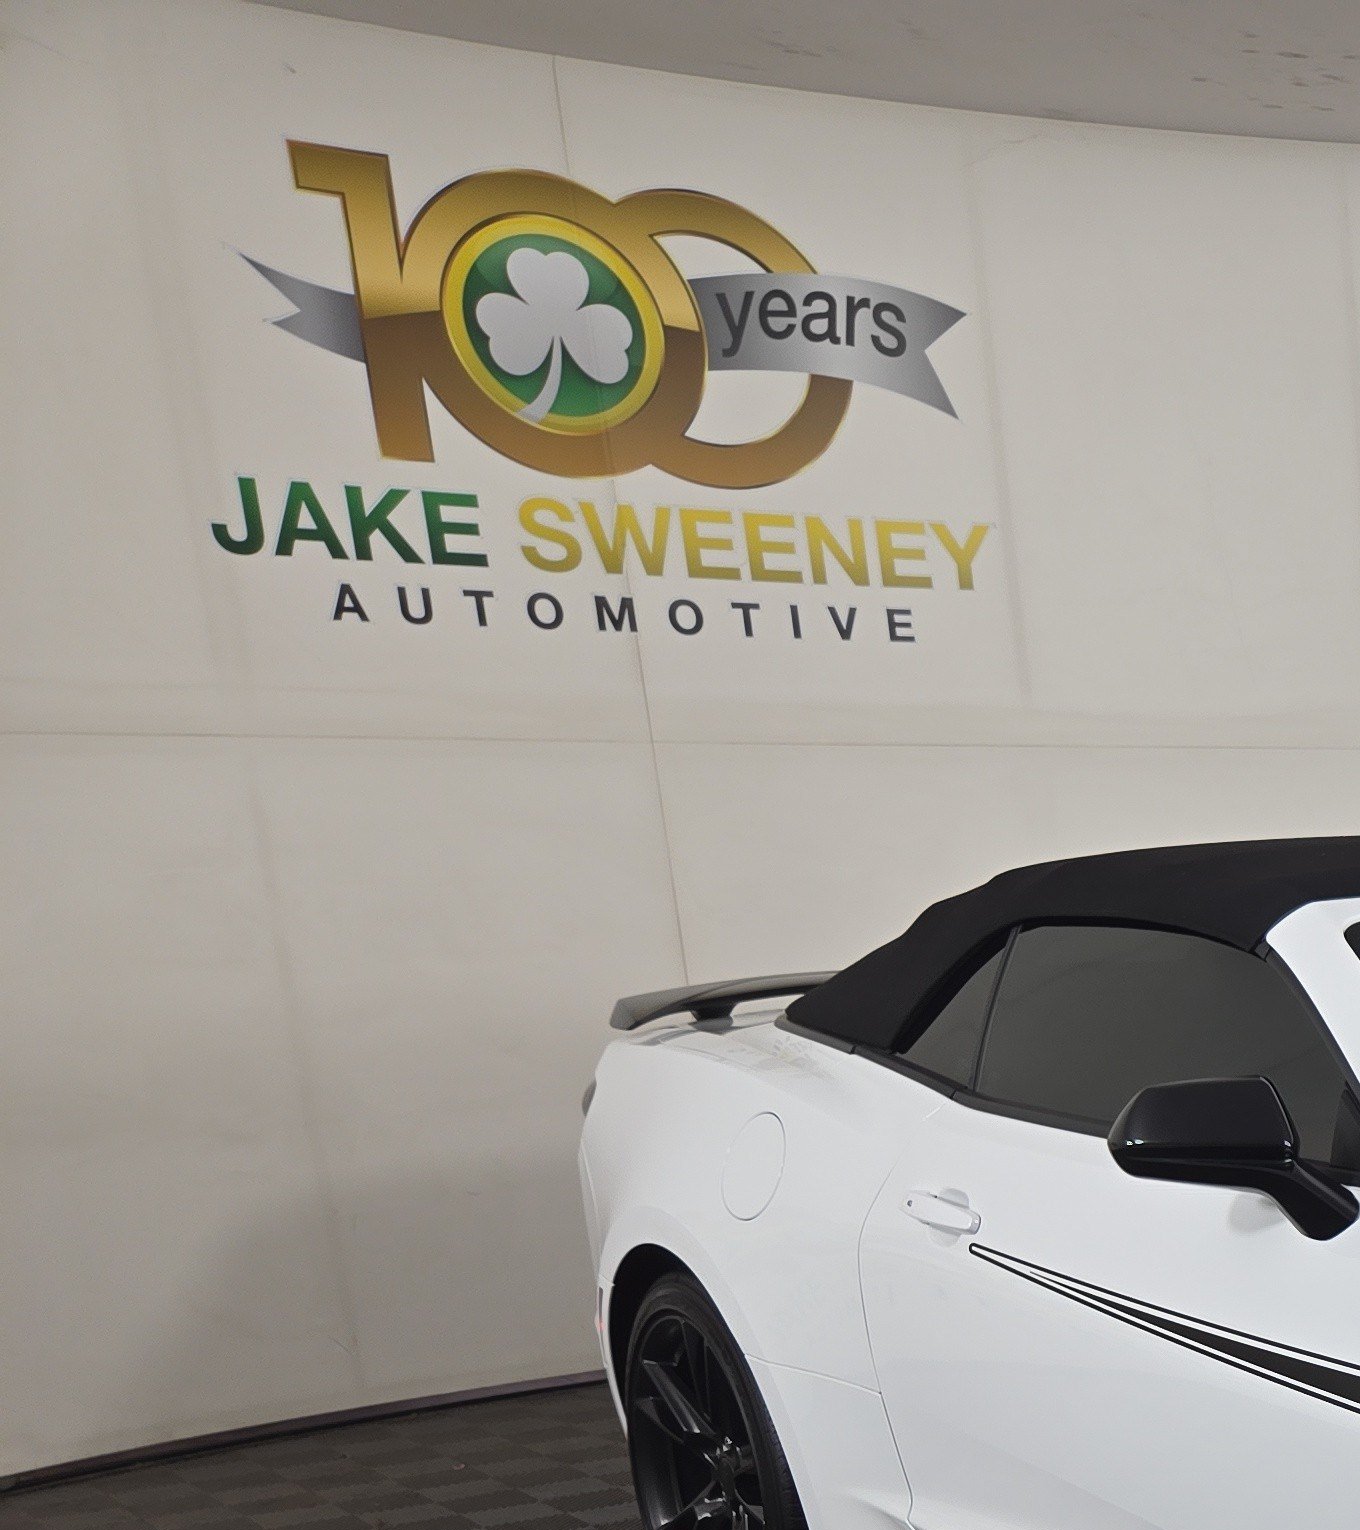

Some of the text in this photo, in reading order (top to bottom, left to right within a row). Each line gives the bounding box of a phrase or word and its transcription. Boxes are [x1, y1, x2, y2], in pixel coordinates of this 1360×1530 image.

[714, 286, 909, 359] years
[210, 476, 992, 592] JAKE SWEENEY
[331, 582, 919, 643] AUTOMOTIVE
